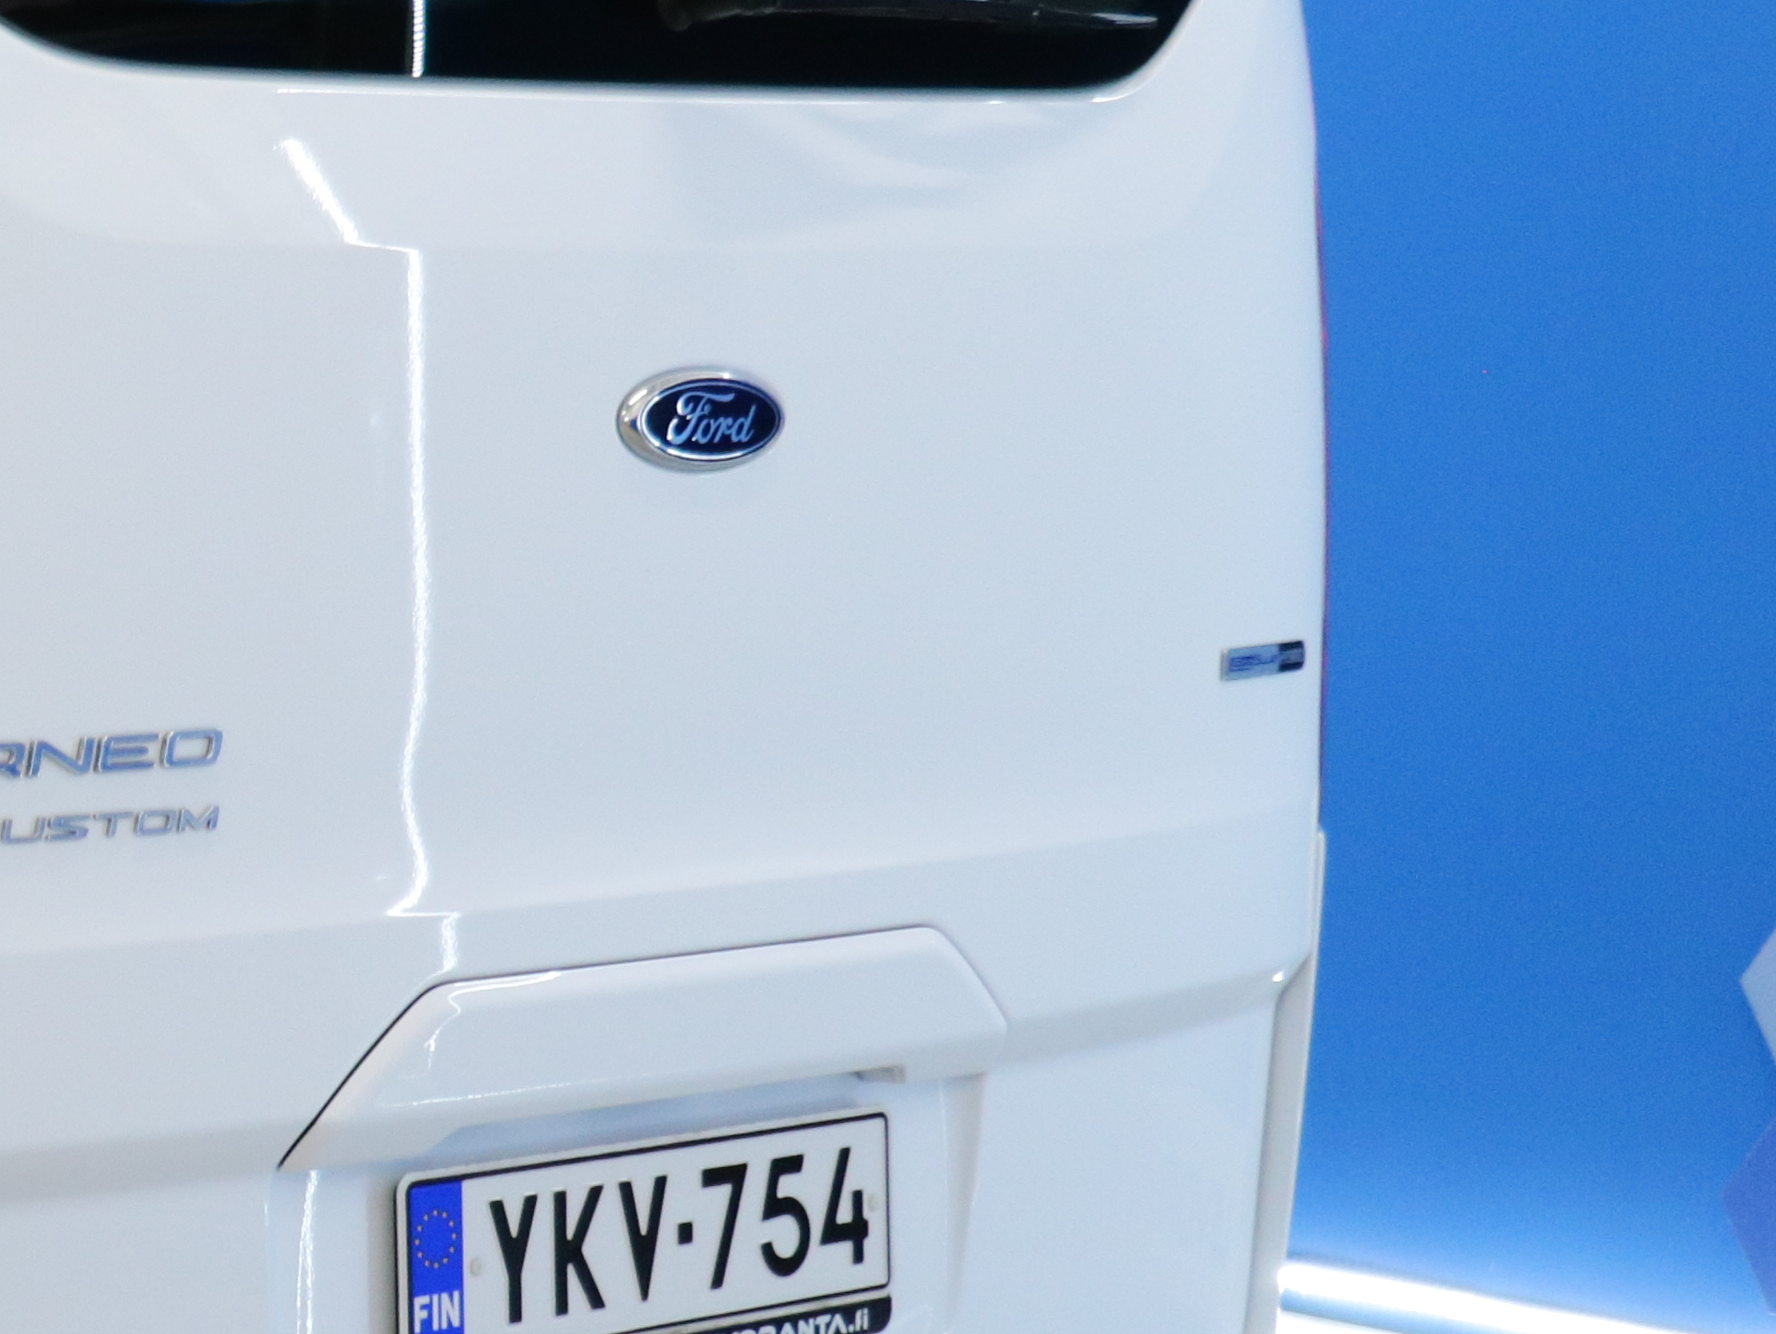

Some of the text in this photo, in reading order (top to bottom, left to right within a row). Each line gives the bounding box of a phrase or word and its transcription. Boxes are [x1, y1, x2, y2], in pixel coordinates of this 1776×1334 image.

[666, 392, 756, 445] Ford
[488, 1146, 869, 1323] YKV-754
[413, 1290, 461, 1334] FIN
